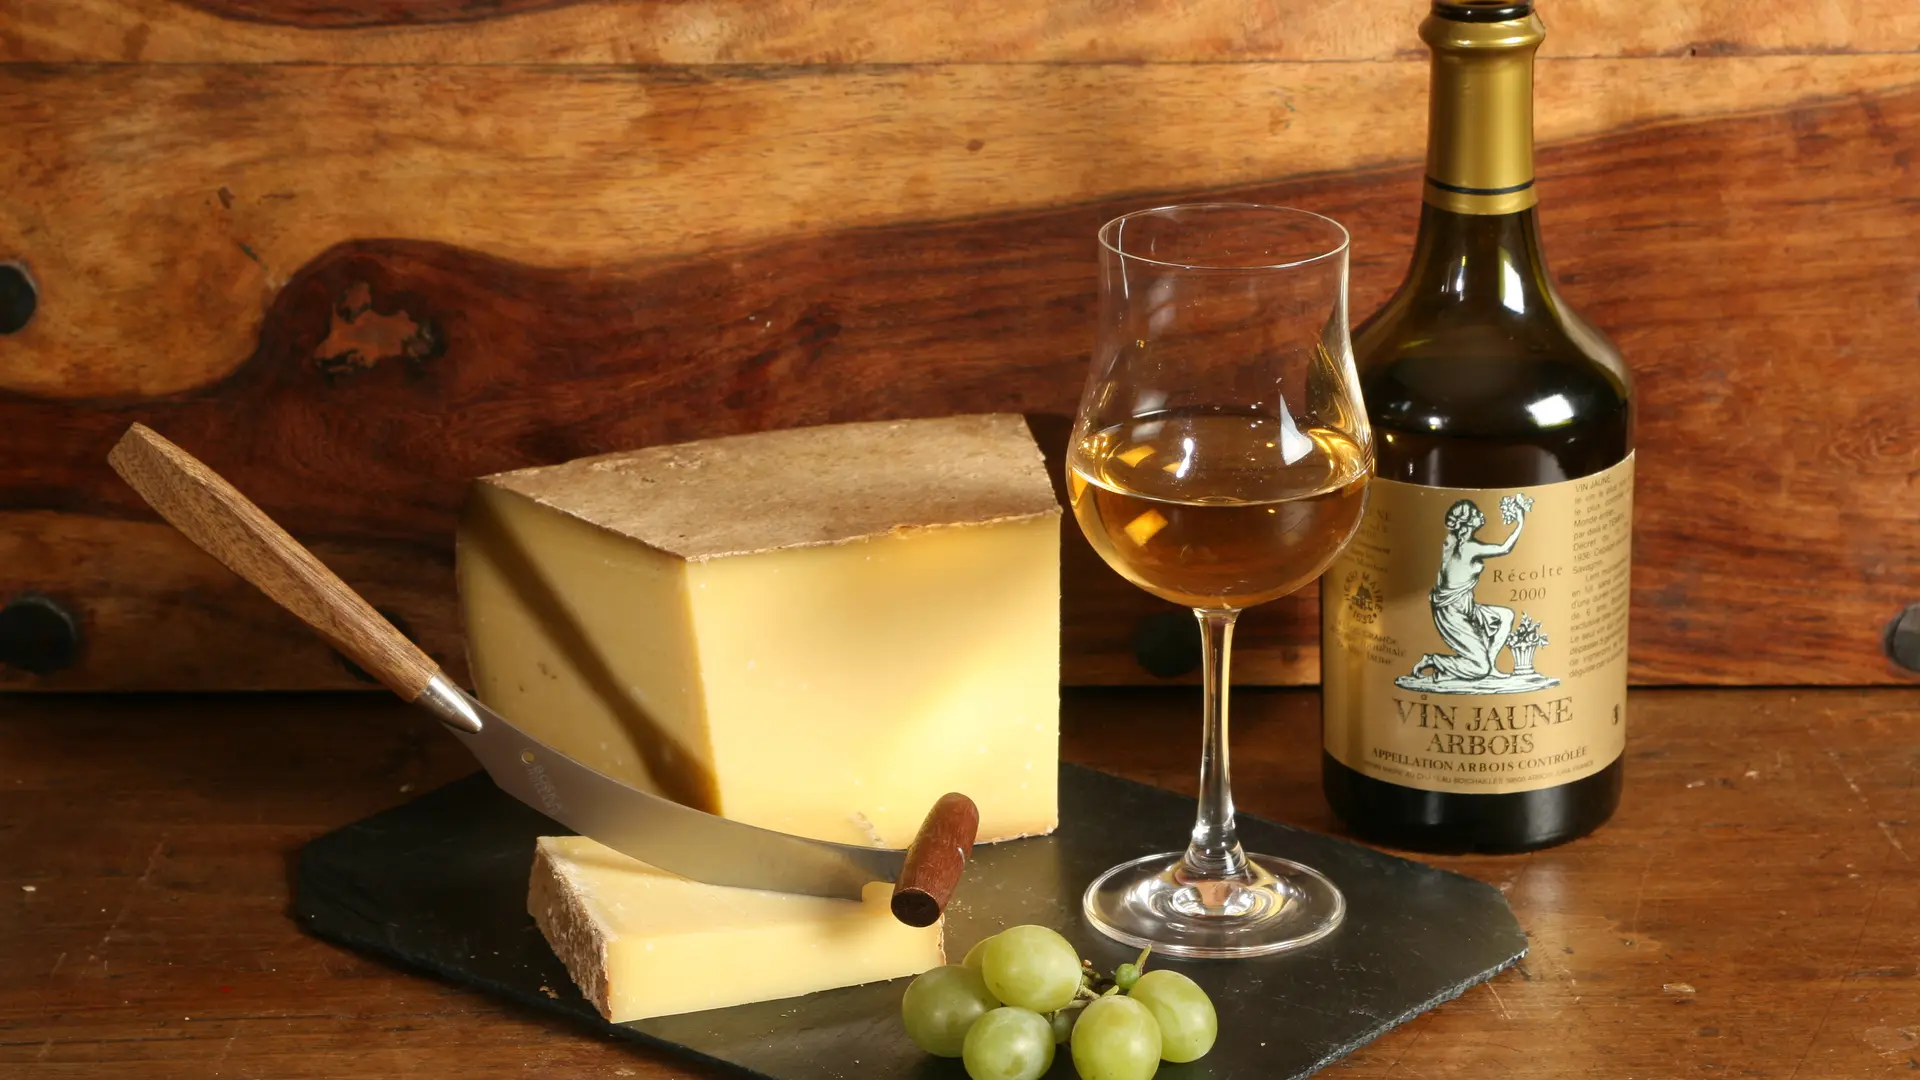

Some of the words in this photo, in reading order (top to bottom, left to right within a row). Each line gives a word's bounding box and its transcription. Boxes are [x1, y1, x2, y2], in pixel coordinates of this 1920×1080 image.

[1575, 483, 1588, 493] VIN
[1493, 564, 1563, 584] Récolte
[1509, 586, 1547, 603] 2000
[1392, 694, 1458, 730] VIN
[1465, 696, 1573, 732] JAUNE
[1425, 732, 1535, 756] ARBOIS
[1371, 746, 1453, 772] APPELLATION
[1456, 762, 1515, 773] ARBOIS
[1517, 744, 1588, 770] CONTRÔLÉE
